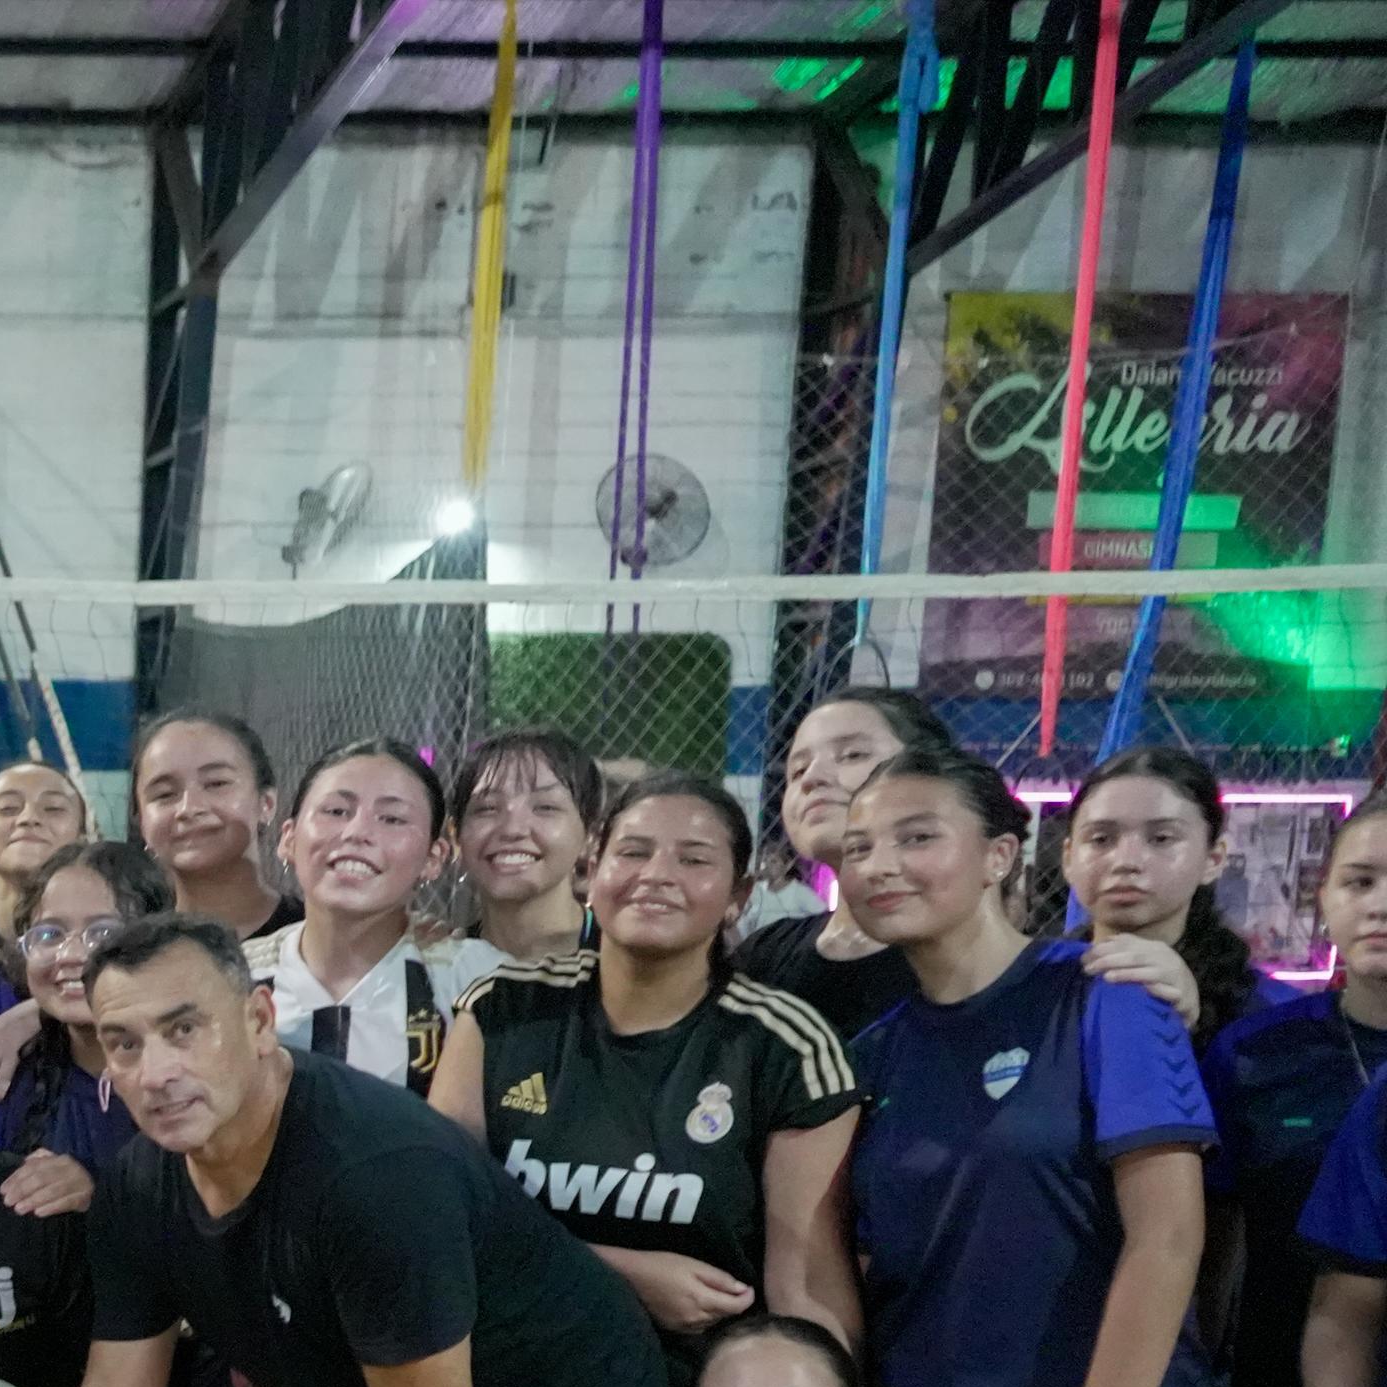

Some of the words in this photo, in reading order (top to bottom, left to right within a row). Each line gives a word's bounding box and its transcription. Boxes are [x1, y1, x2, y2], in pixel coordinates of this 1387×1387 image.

[965, 358, 1311, 487] Alleria
[1083, 537, 1157, 560] GIMNASI
[500, 1093, 548, 1115] adidas
[504, 1139, 705, 1225] bwin
